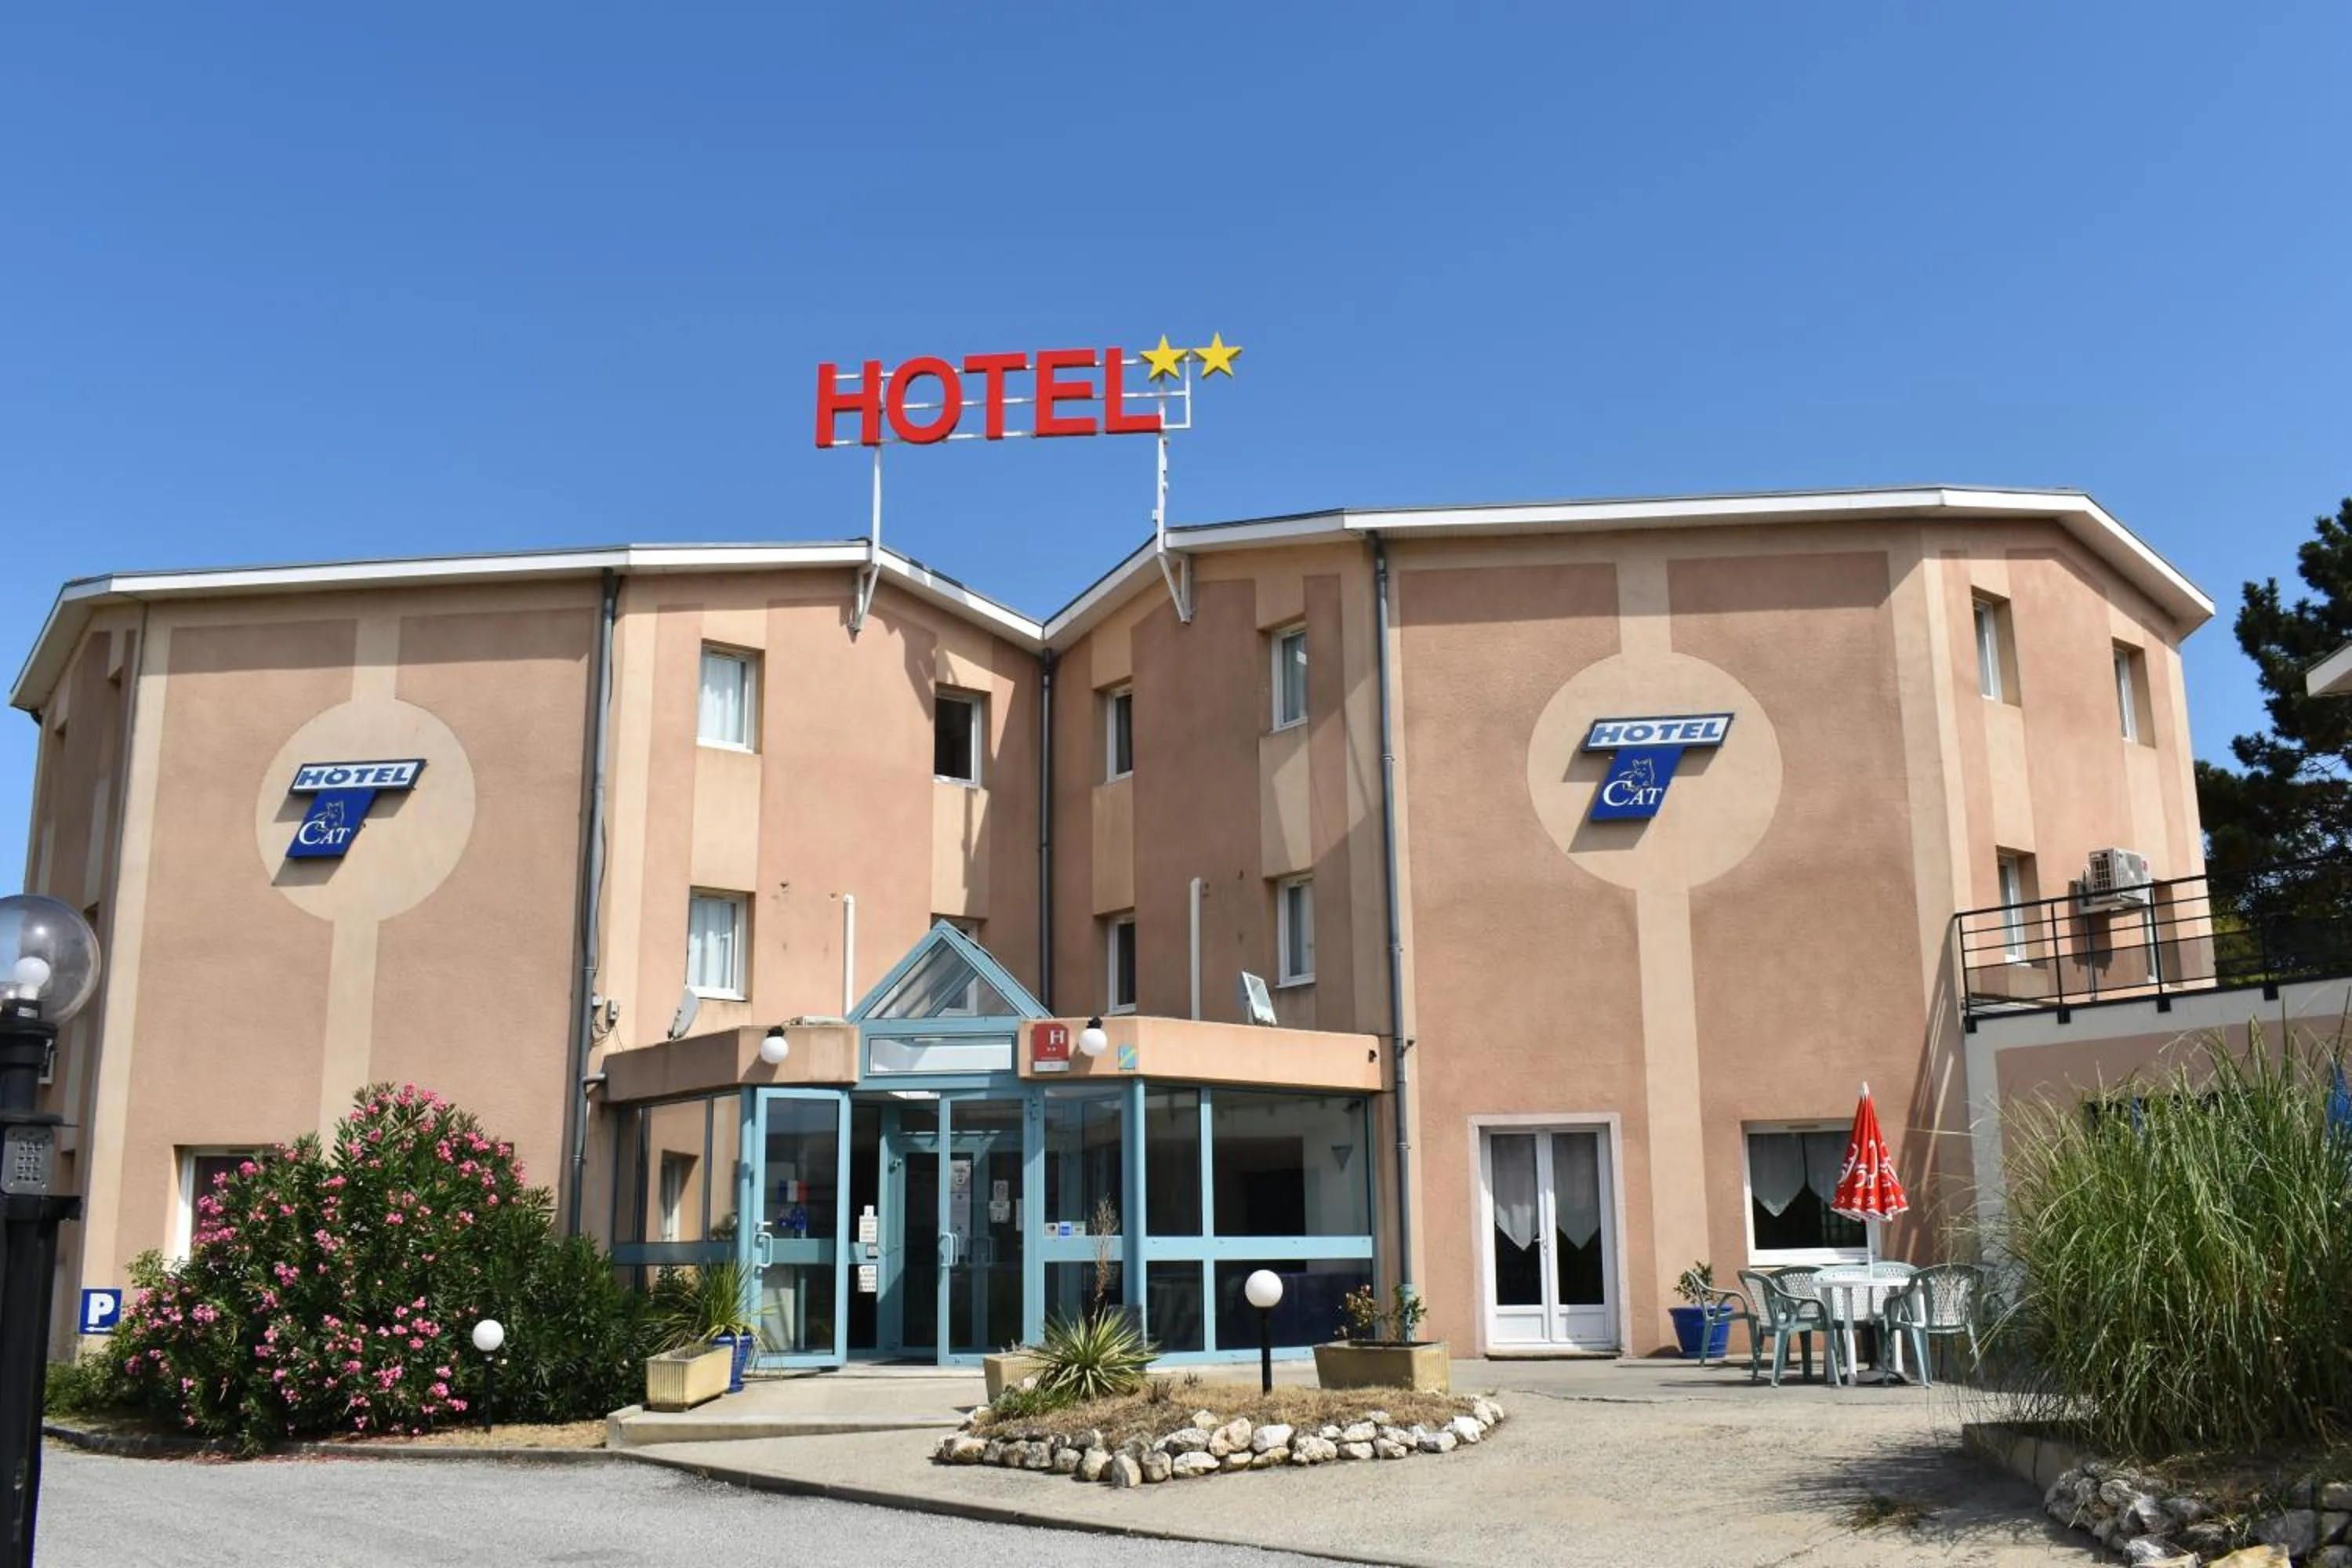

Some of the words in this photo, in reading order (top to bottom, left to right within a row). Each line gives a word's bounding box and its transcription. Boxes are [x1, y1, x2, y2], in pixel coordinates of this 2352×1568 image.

[815, 347, 1162, 449] HOTEL
[1590, 722, 1720, 743] HOTEL
[297, 767, 408, 786] HOTEL
[1603, 780, 1663, 807] CAT
[299, 820, 350, 845] CAT
[1050, 1029, 1064, 1044] H
[88, 1293, 115, 1324] P
